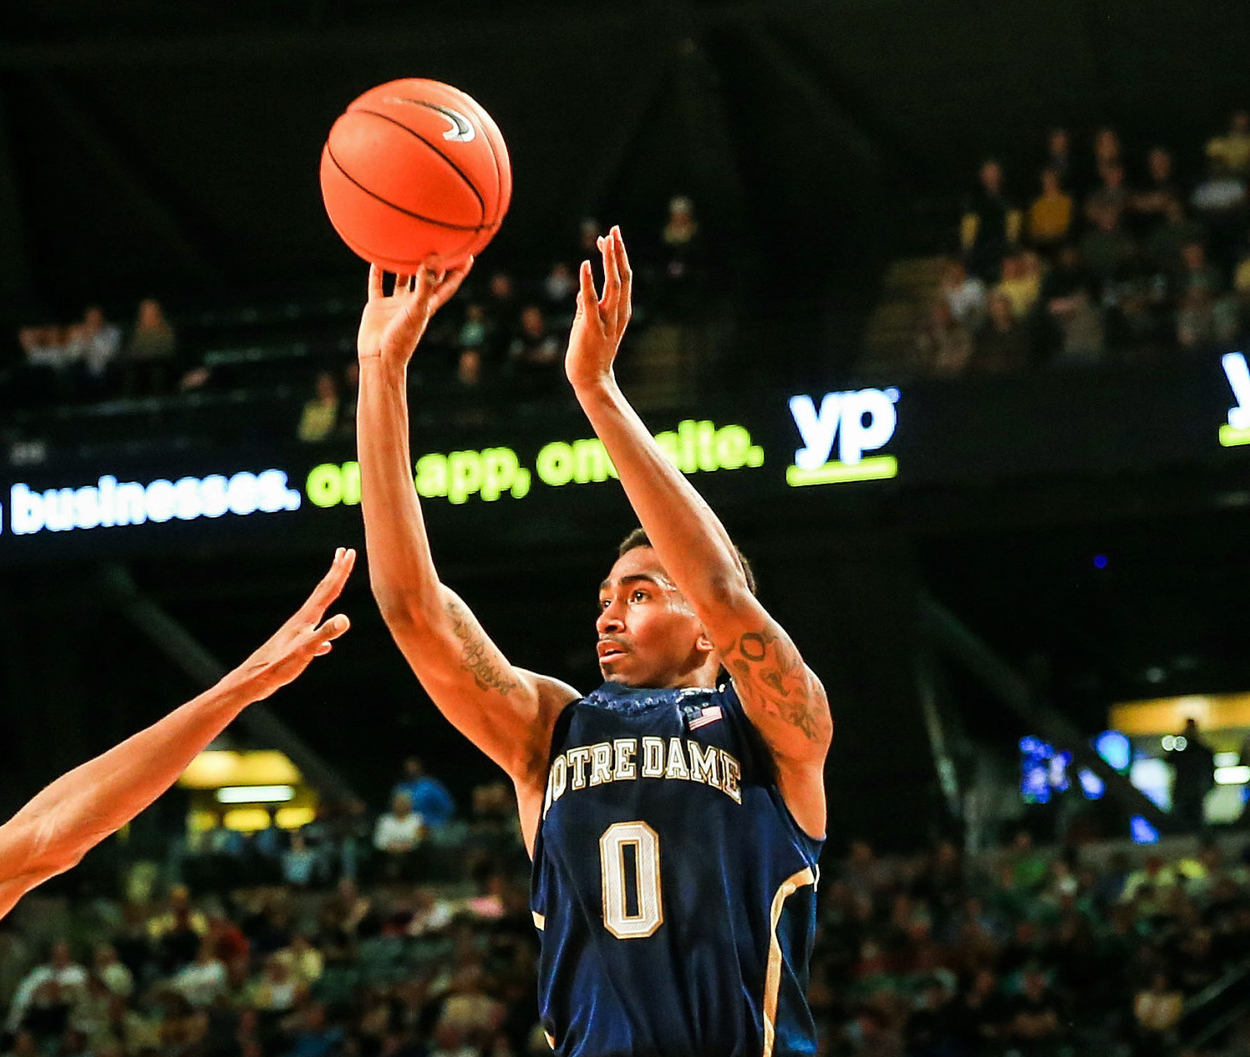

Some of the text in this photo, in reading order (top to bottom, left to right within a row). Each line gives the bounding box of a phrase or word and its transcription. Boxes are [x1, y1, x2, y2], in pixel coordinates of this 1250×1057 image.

[788, 388, 898, 471] yp
[11, 474, 301, 535] businesses.
[414, 446, 531, 505] app,
[536, 437, 622, 486] on
[642, 736, 742, 806] DAME
[599, 820, 664, 939] 0
